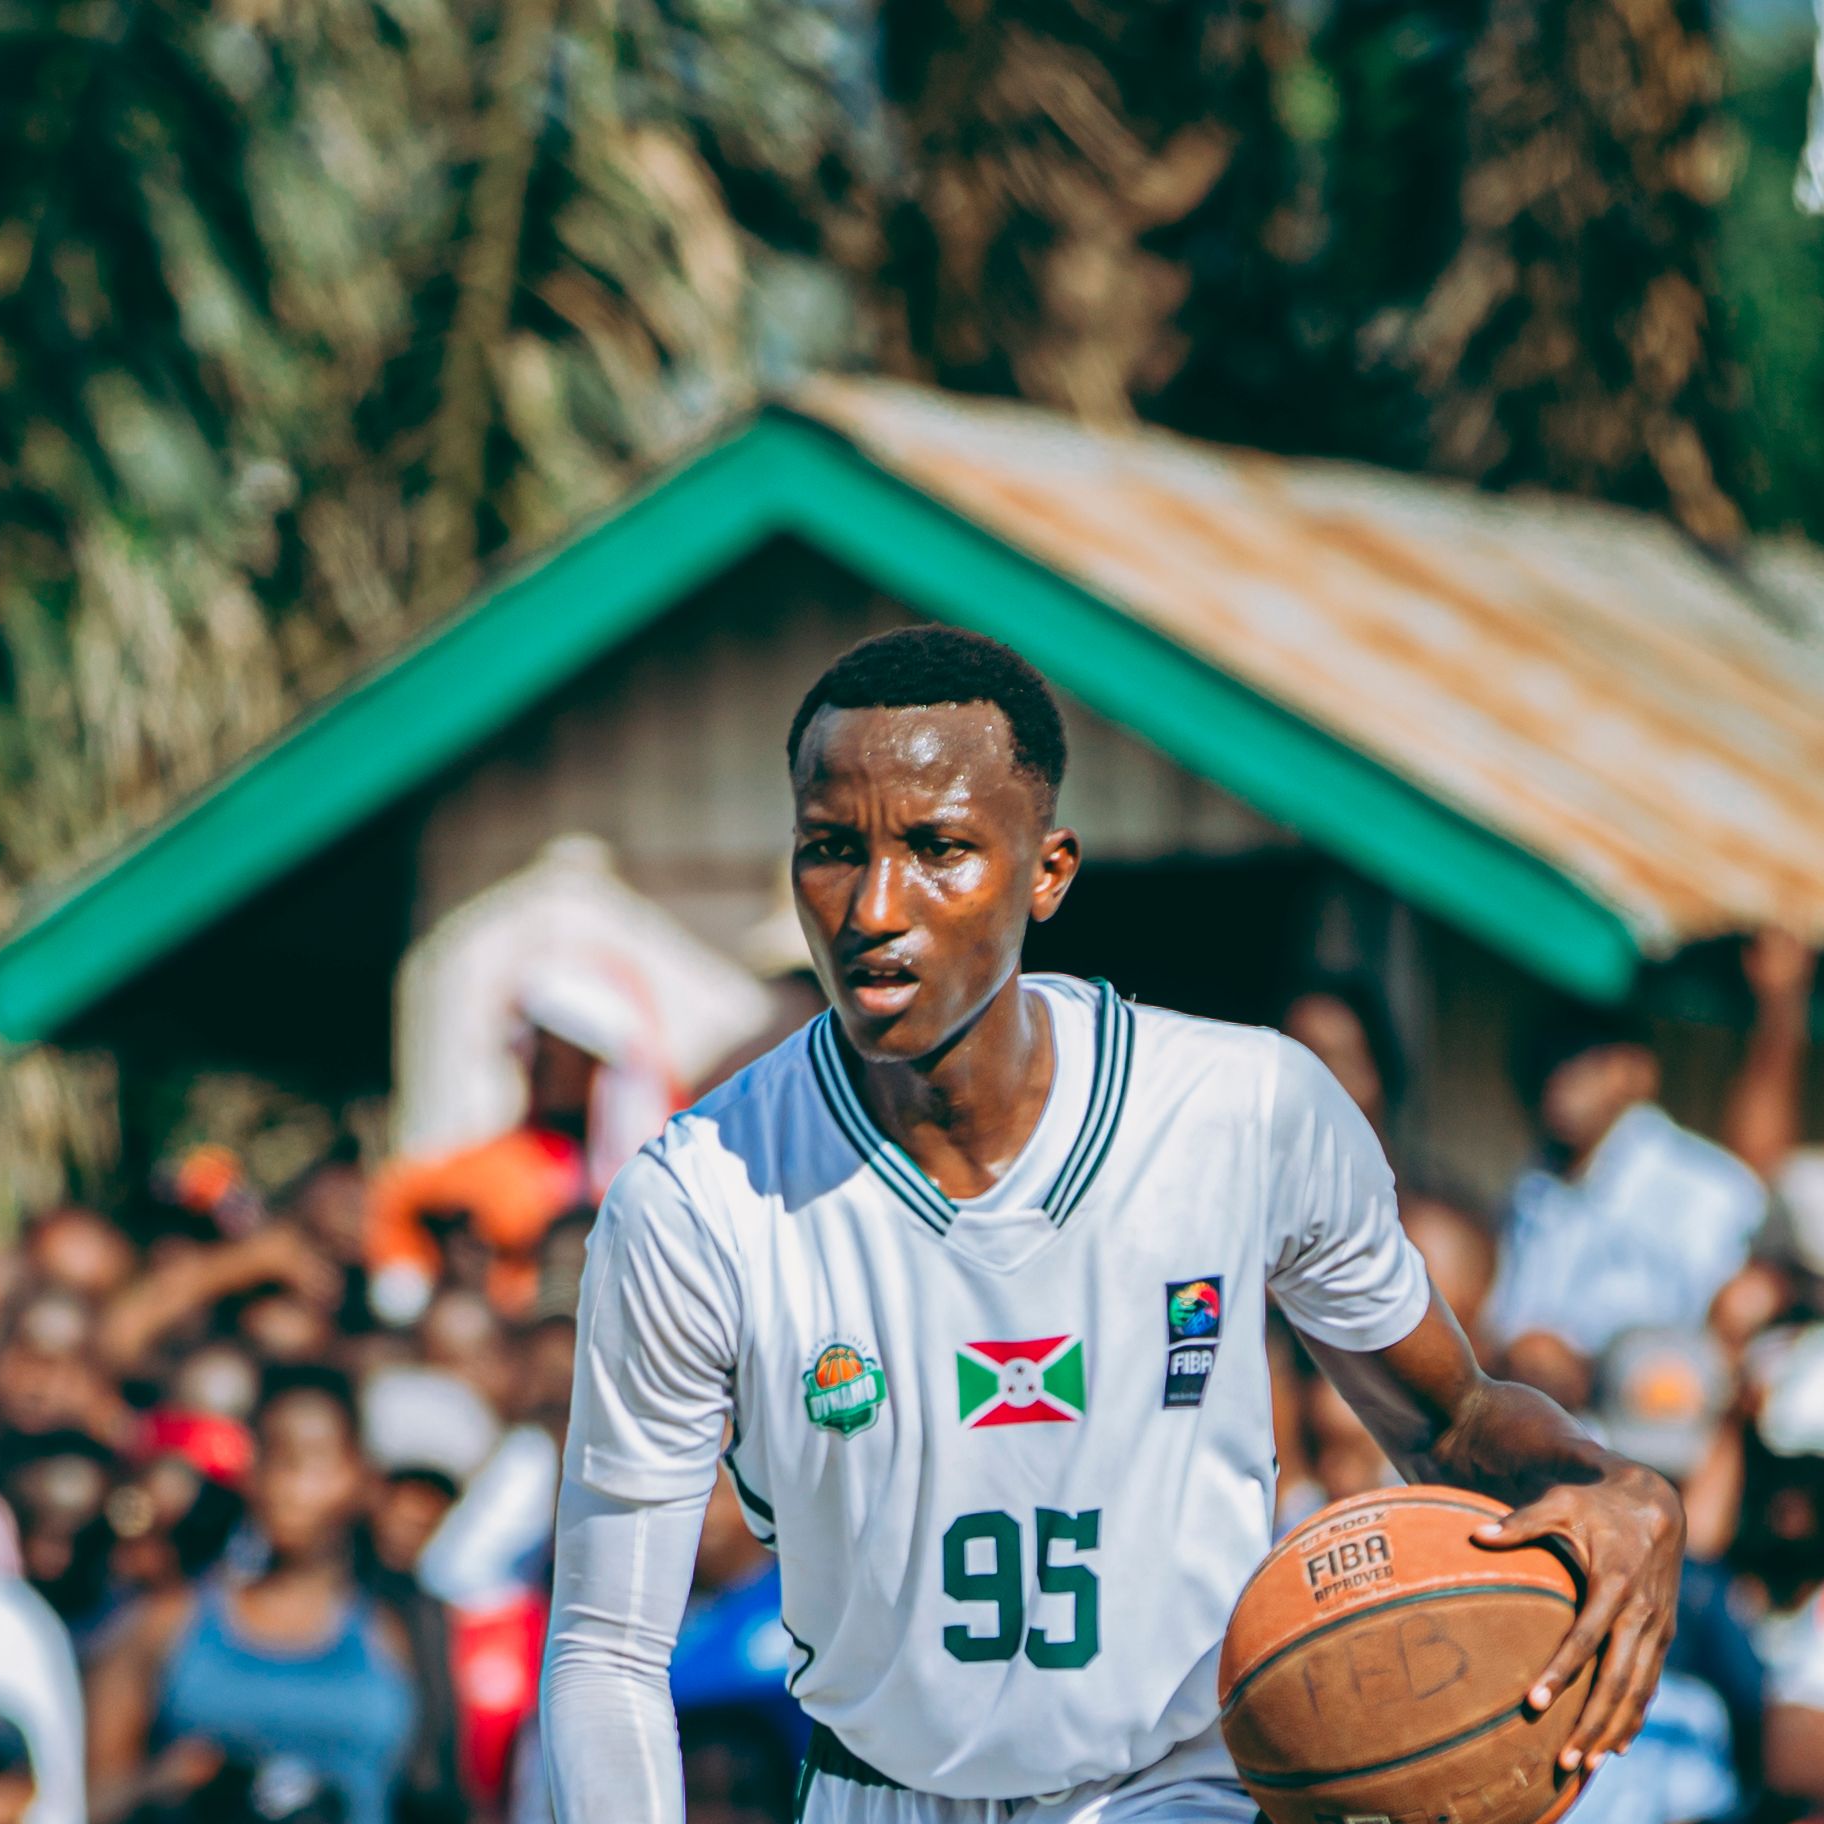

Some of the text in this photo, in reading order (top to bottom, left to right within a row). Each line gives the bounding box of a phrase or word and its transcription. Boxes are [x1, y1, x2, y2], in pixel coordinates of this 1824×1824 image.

[1169, 1349, 1215, 1376] FIBA
[1307, 1535, 1392, 1588] FIBA
[1312, 1565, 1395, 1604] APPROVED
[942, 1506, 1102, 1669] 95
